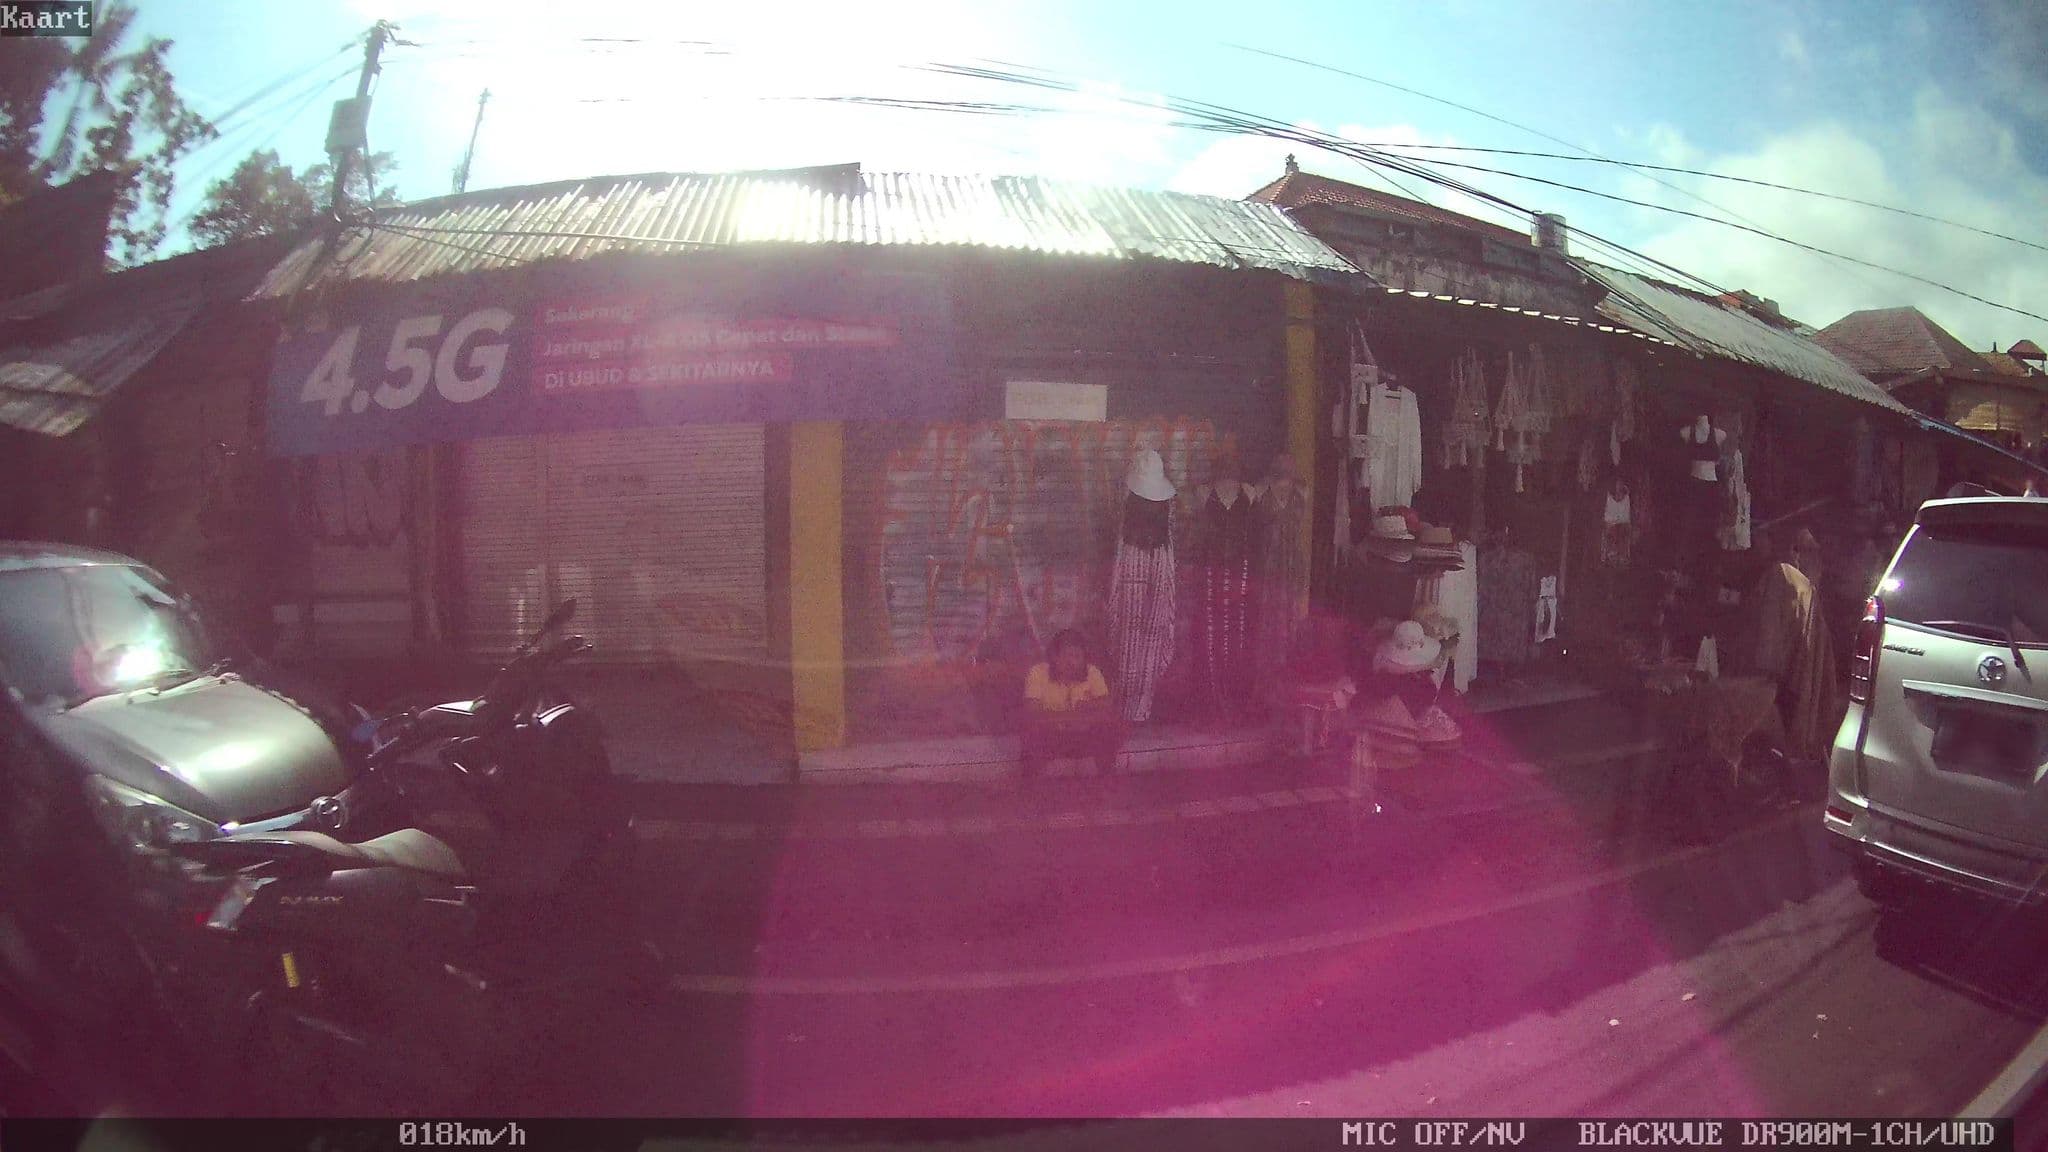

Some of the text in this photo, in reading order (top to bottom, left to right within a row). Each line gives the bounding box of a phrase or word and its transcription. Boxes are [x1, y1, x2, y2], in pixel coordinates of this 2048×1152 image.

[543, 337, 626, 360] Jaringan
[781, 324, 821, 343] dan
[299, 307, 515, 416] 4.5G
[568, 367, 624, 388] UBUD
[628, 366, 643, 384] &
[646, 359, 775, 383] SEKITARNYA
